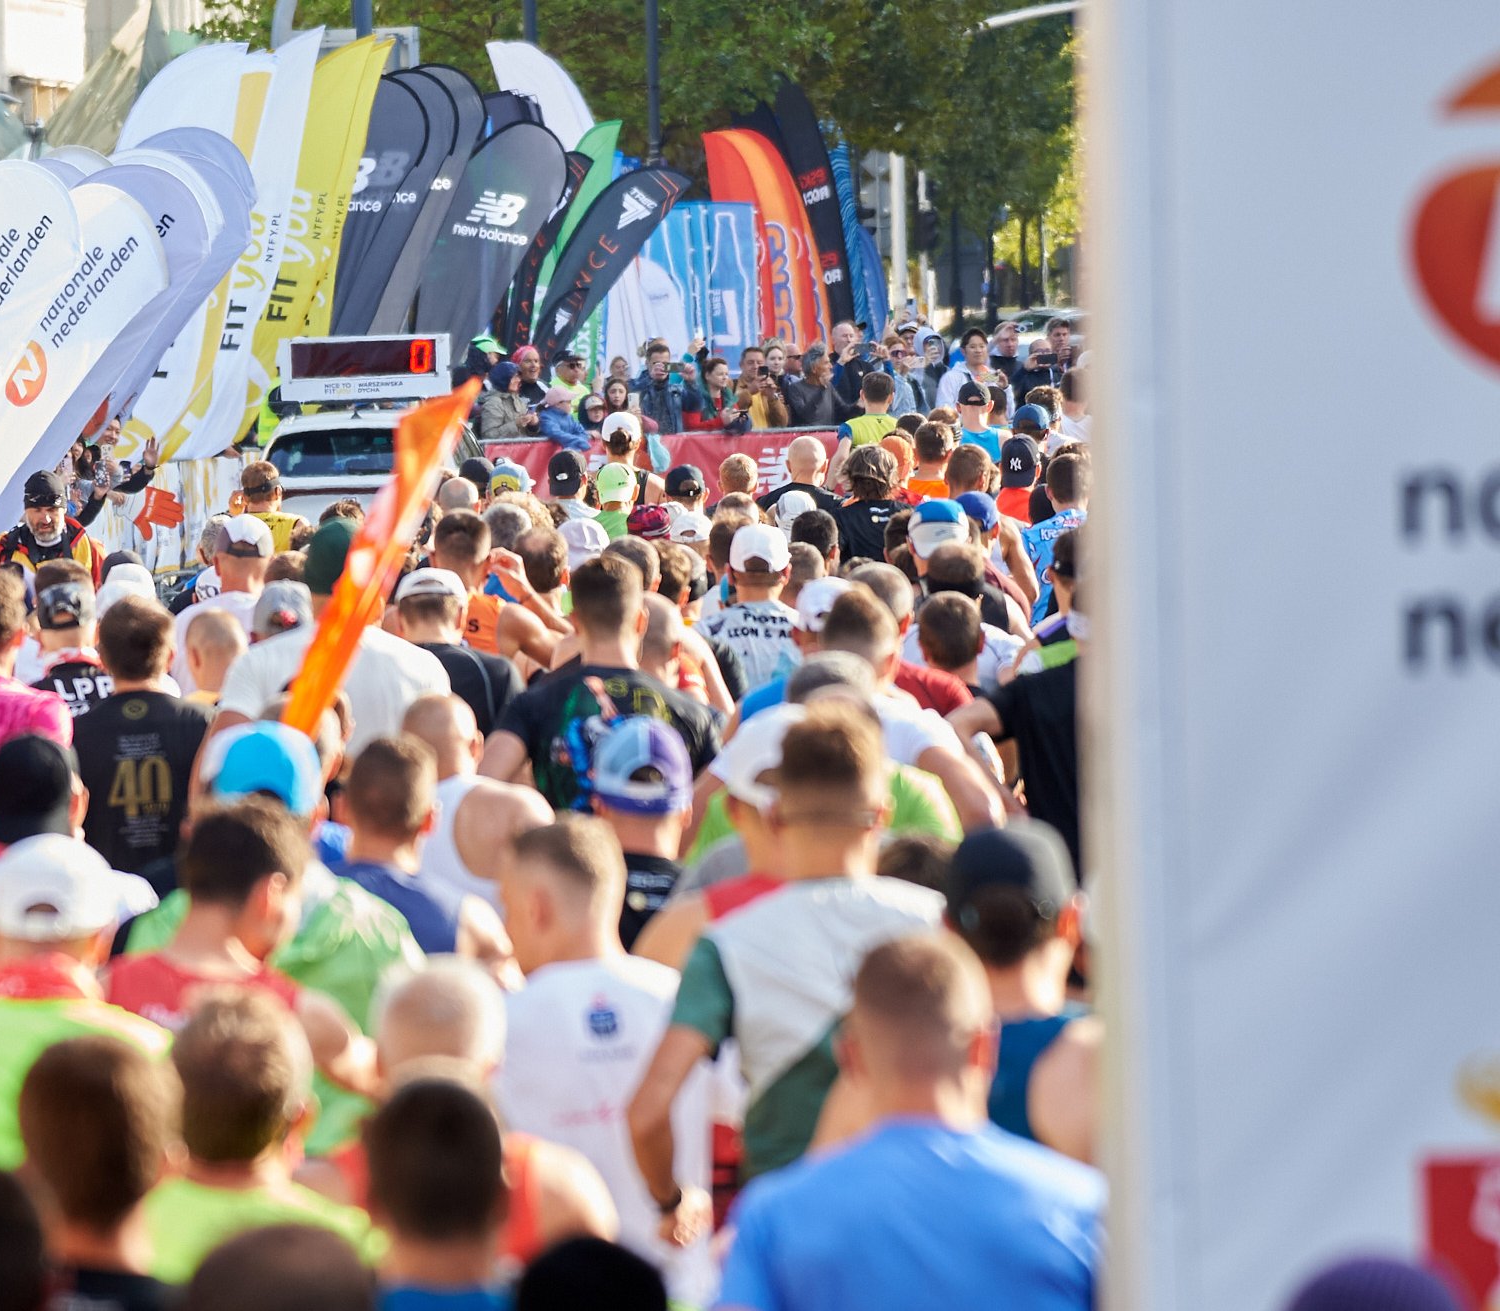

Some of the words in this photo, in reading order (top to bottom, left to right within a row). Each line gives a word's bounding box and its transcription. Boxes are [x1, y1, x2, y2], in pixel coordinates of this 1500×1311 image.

[452, 223, 478, 238] new
[478, 226, 529, 246] balance
[39, 246, 105, 332] nationale
[51, 235, 139, 349] nederlanden
[266, 269, 297, 322] FIT
[108, 755, 173, 818] 40
